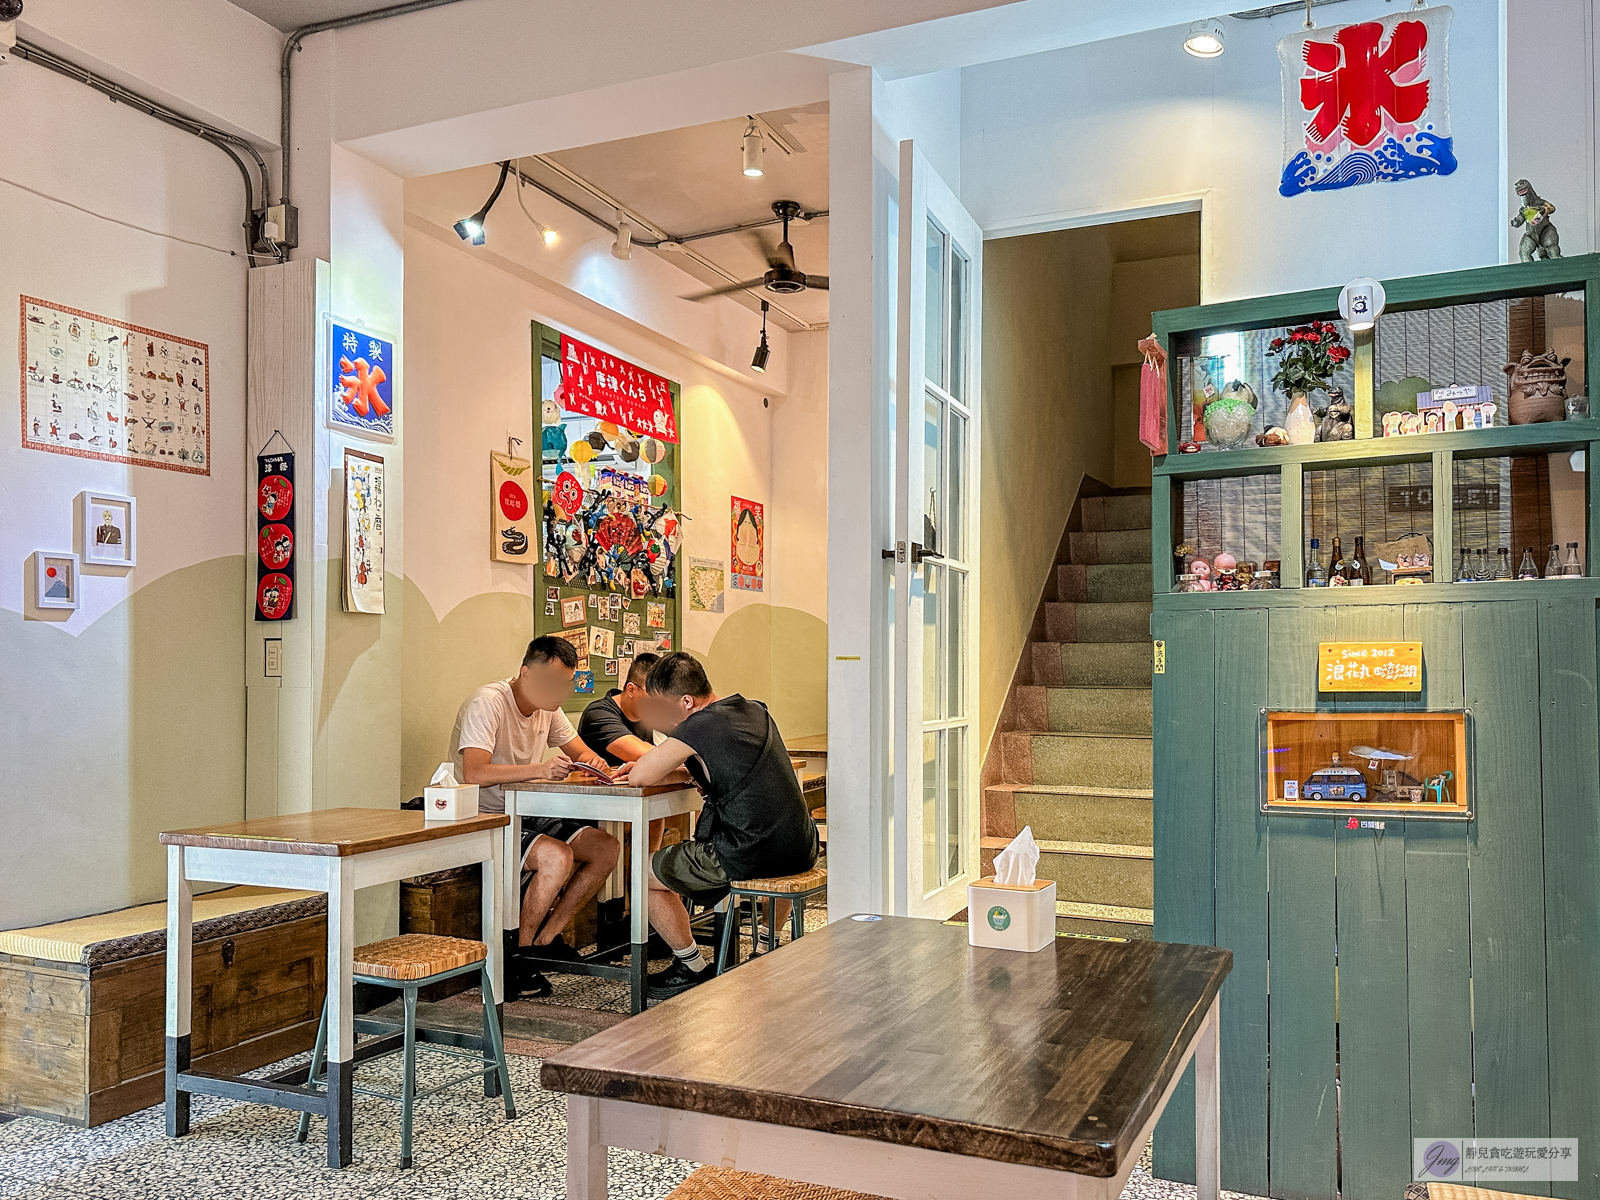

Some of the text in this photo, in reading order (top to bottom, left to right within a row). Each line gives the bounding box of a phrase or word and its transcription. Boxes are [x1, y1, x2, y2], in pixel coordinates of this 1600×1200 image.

[1299, 20, 1430, 146] 氷
[342, 332, 384, 362] 特製
[339, 354, 392, 418] 氷
[595, 371, 647, 402] 唐津くんち
[1400, 488, 1498, 507] TOET
[1341, 648, 1395, 659] Since 2012
